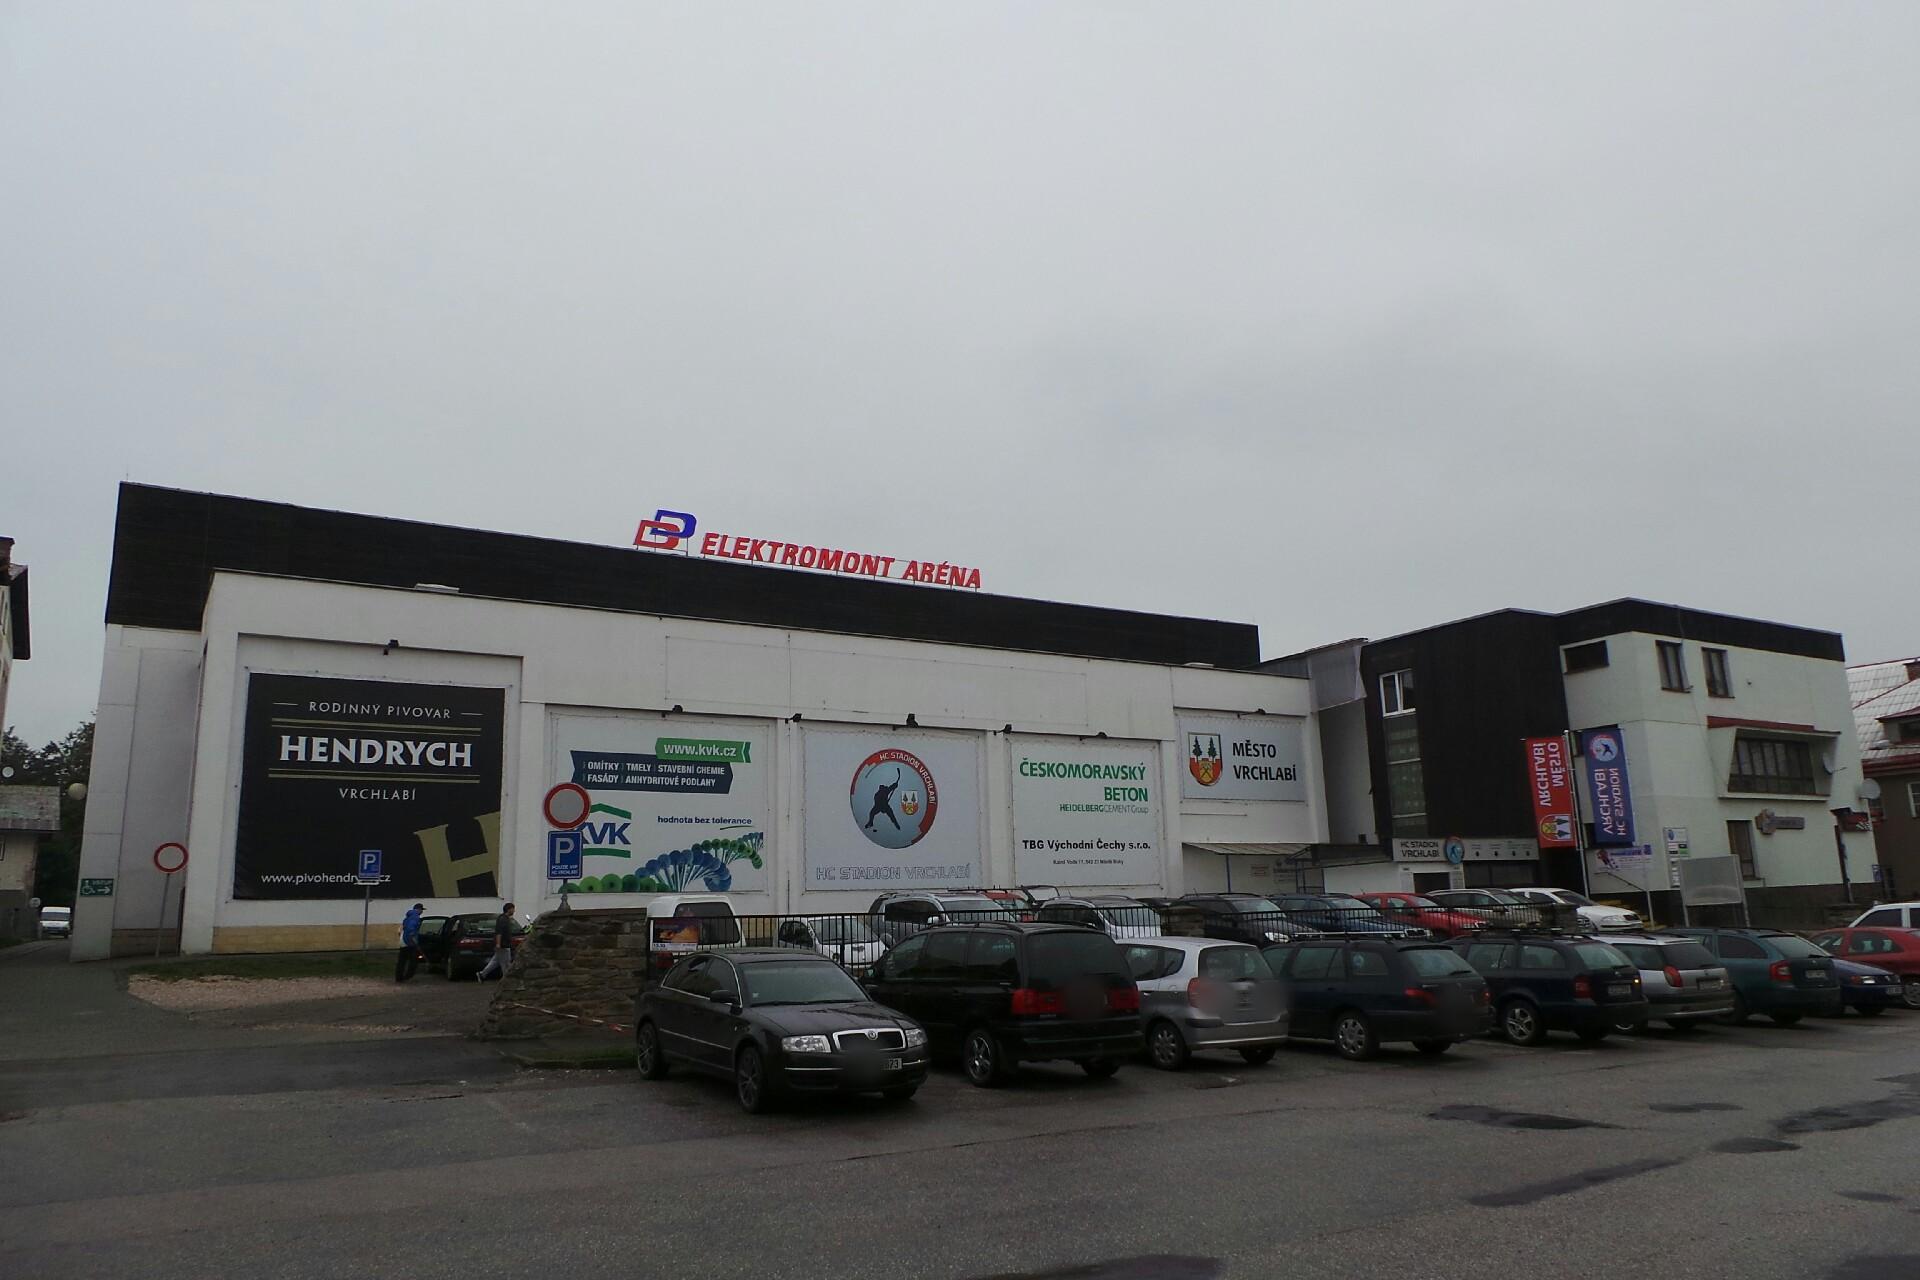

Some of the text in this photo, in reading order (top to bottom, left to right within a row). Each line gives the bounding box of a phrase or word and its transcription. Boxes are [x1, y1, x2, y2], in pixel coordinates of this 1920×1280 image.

[700, 532, 981, 588] ELEKTROMONT ARÉNA
[309, 701, 451, 719] RODINNÝ PIVOVAR
[279, 735, 472, 767] HENDRYCH
[663, 743, 737, 757] www.kvk.cz
[1232, 739, 1277, 758] MĚSTO
[587, 760, 725, 775] OMÍTKY TMELY STAVEBNÍ CHEMIE
[1019, 757, 1146, 781] ČESKOMORAVSKÝ
[1232, 764, 1297, 781] VRCHLABÍ
[587, 772, 716, 787] FASÁDY ANHYDRITOVÉ PODLAHY
[879, 751, 936, 805] HC STADION VRCHLABÍ
[338, 787, 416, 801] VRCHLABÍ
[1104, 786, 1148, 802] BETON
[657, 815, 752, 825] hodnota bez tolerance
[555, 837, 575, 864] P
[1022, 838, 1151, 851] TBG Východní Čechy s.r.o.
[363, 853, 376, 870] P
[261, 873, 392, 885] www.pivohendrycz
[816, 863, 970, 880] HC STADION VRCHLABÍ
